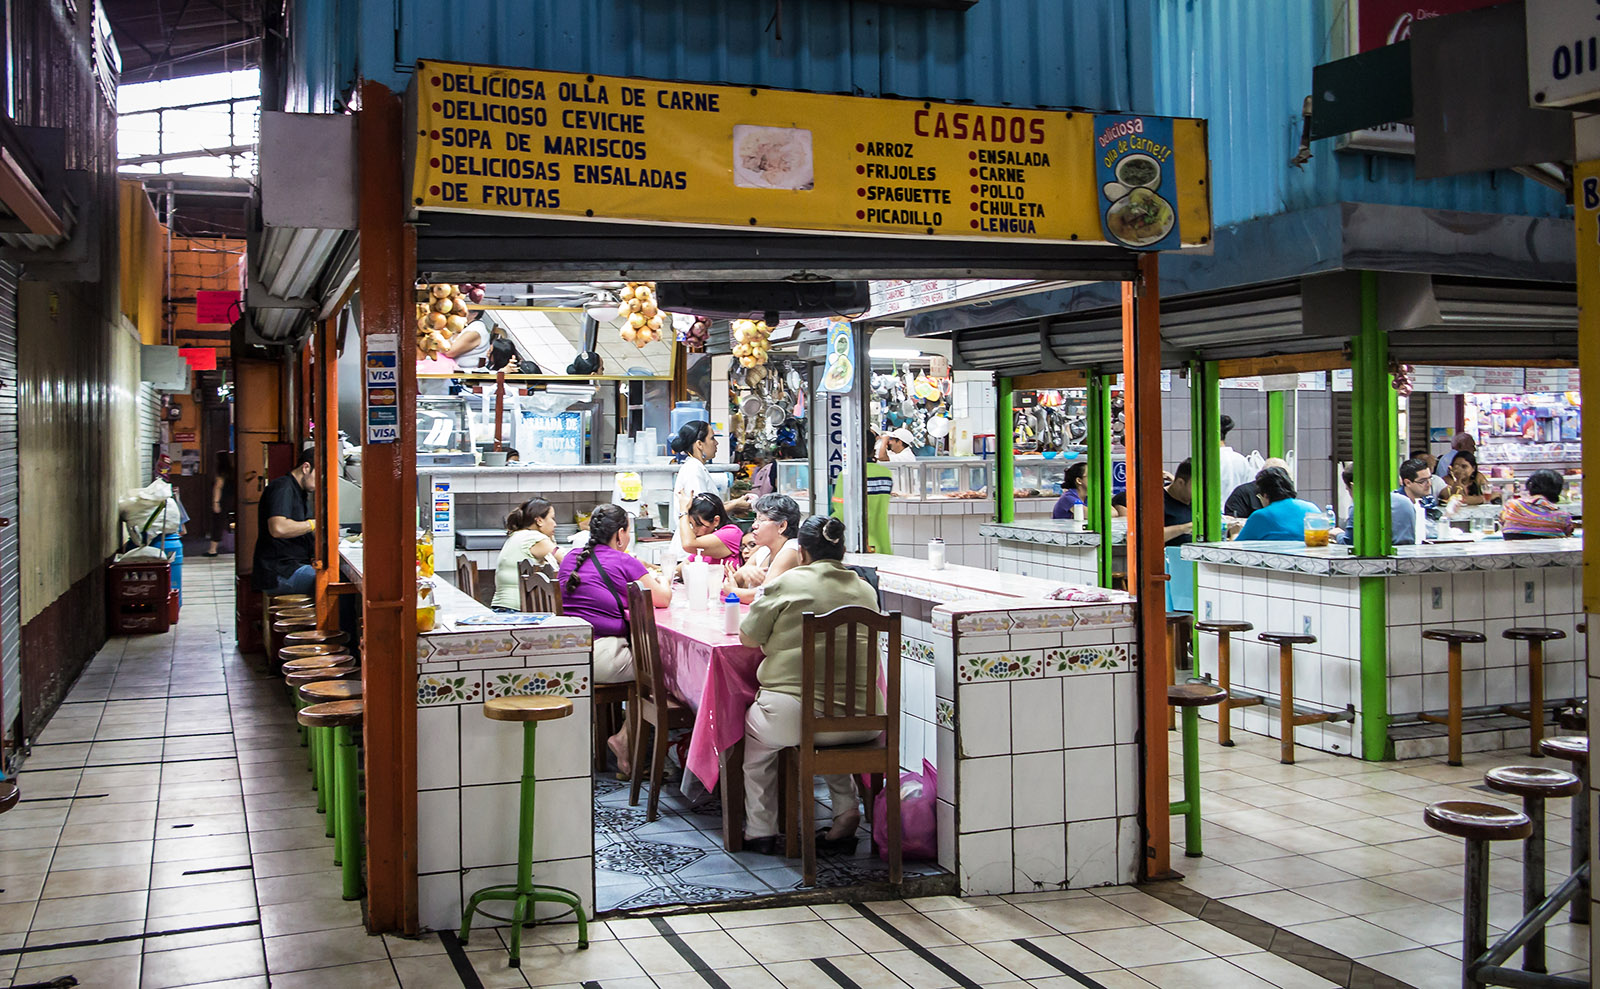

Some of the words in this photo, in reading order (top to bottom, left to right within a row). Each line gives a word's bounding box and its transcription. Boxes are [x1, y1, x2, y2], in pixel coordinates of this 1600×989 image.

[442, 73, 546, 101] DELICIOSA
[559, 82, 609, 104] OLLA
[621, 87, 646, 107] DE
[657, 90, 720, 113] CARNE
[443, 100, 547, 128] DELICIOSO
[562, 110, 645, 134] CEVICHE
[914, 109, 1045, 145] CASADOS
[1098, 117, 1144, 147] Deliciosa
[442, 127, 492, 150] SOPA
[506, 132, 531, 153] DE
[544, 136, 647, 161] MARISCOS
[867, 142, 913, 158] ARROZ
[1118, 140, 1129, 154] de
[978, 150, 1050, 169] ENSALADA
[442, 155, 560, 182] DELICIOSAS
[574, 165, 687, 190] ENSALADAS
[867, 164, 936, 182] FRIJOLES
[980, 166, 1025, 183] CARNE
[442, 182, 468, 203] DE
[483, 185, 560, 209] FRUTAS
[867, 186, 951, 204] SPAGUETTE
[981, 184, 1024, 201] POLLO
[867, 208, 942, 226] PICADILLO
[980, 200, 1045, 218] CHULETA
[980, 218, 1036, 234] LENGUA
[371, 371, 395, 380] VISA
[372, 429, 396, 438] VISA
[566, 418, 578, 431] DE
[542, 437, 575, 450] FRUTAS
